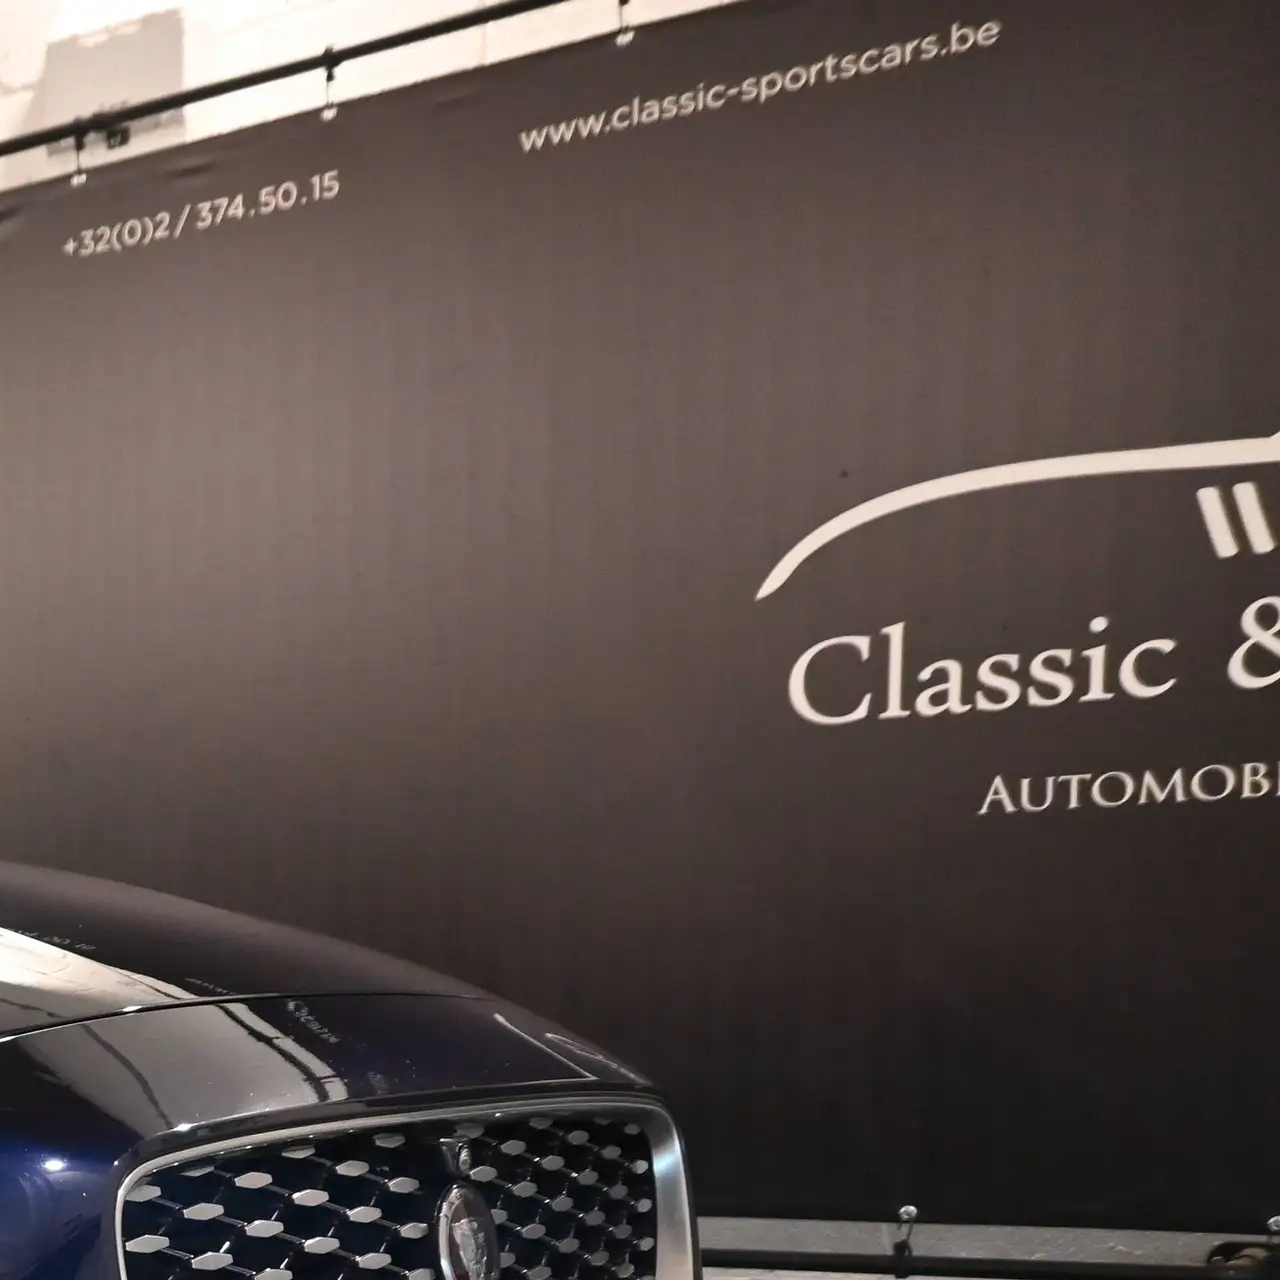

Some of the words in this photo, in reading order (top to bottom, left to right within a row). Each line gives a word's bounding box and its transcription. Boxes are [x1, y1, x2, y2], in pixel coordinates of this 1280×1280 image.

[519, 18, 1002, 152] www.classic-sportscars.be
[788, 615, 1179, 726] Classic
[1227, 595, 1280, 690] &
